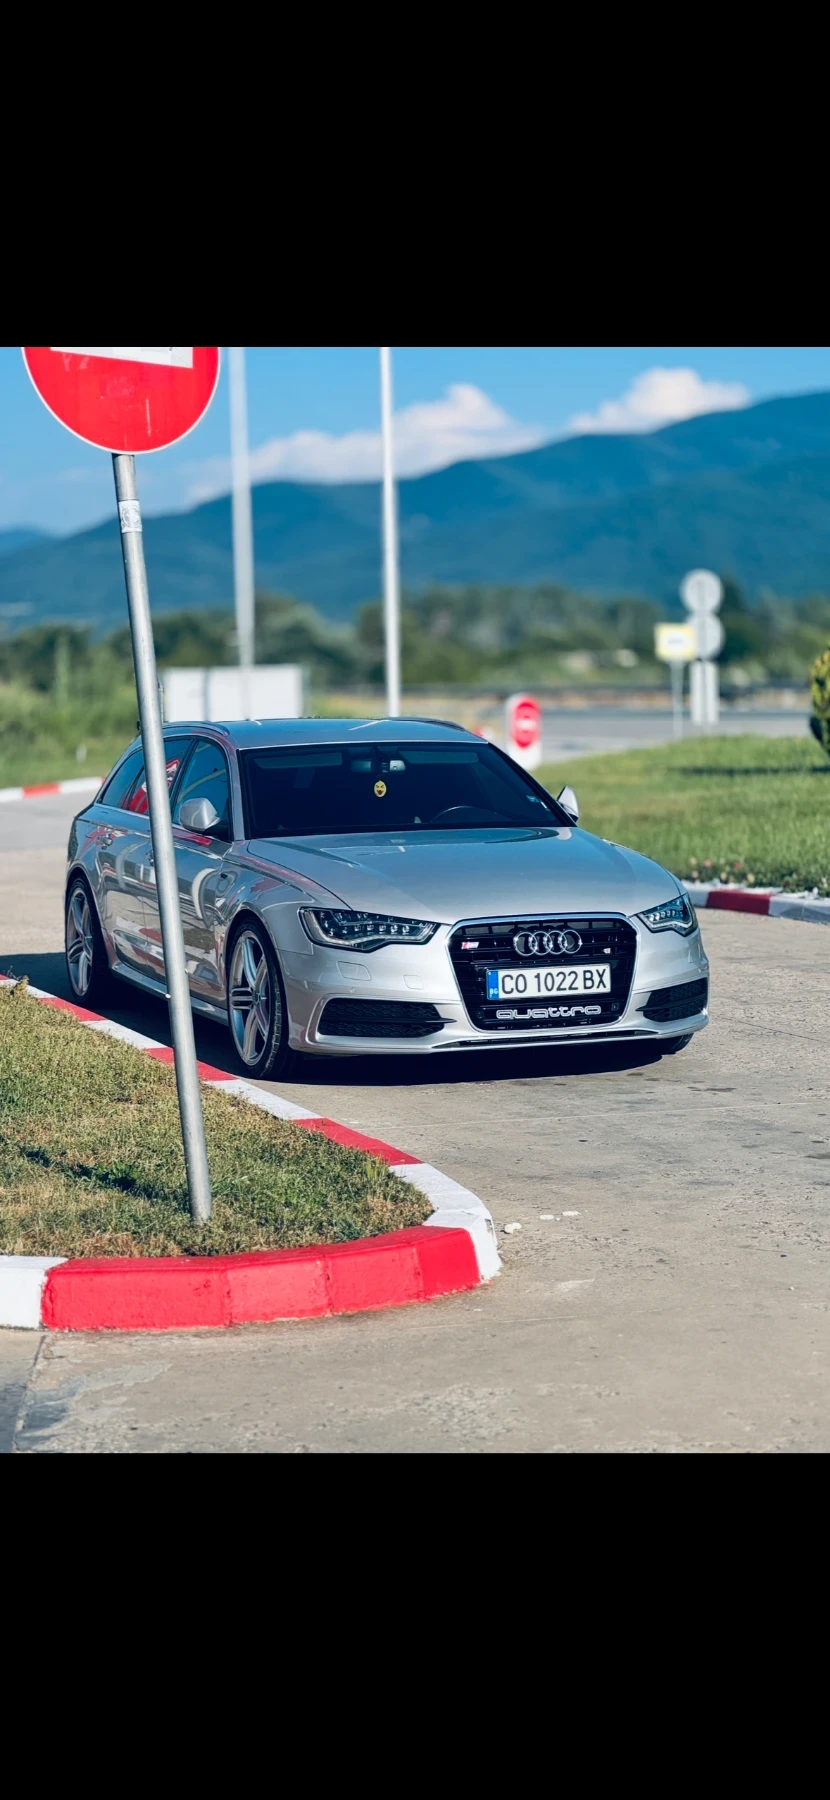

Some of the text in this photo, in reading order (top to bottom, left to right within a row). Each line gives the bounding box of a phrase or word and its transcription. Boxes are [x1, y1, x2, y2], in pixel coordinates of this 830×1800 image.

[502, 969, 606, 994] CO 1022 BX
[496, 1005, 601, 1019] quattro
